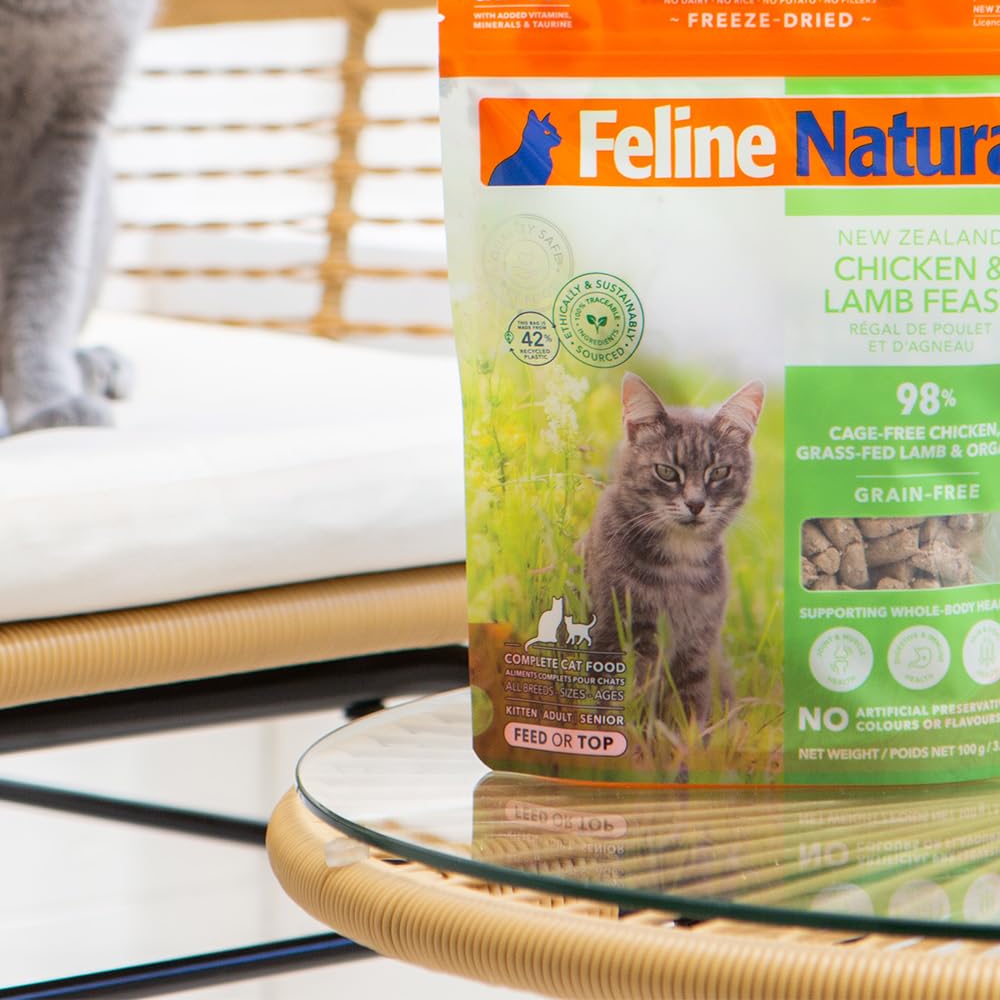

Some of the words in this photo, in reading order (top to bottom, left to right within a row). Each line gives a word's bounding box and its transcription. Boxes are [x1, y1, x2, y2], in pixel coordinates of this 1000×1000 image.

[688, 13, 853, 28] FREEZE-DRIED
[579, 103, 776, 179] Feline
[838, 229, 890, 246] NEW
[834, 256, 976, 281] CHICKEN
[586, 297, 621, 320] TRACEABLE
[824, 288, 913, 313] LAMB
[559, 284, 581, 340] ETHICALLY
[585, 280, 592, 289] &
[596, 279, 638, 341] SUSTAINABLY
[578, 328, 619, 345] INGREDIENTS
[849, 320, 900, 336] RÉGAL
[906, 323, 927, 335] DE
[933, 323, 992, 335] POULET
[576, 345, 625, 362] SOURCED
[869, 341, 887, 352] ET
[897, 382, 956, 416] 98%
[829, 426, 925, 440] CAGE-FREE
[929, 423, 1000, 439] CHICKEN,
[797, 446, 896, 460] GRASS-FED
[900, 444, 946, 459] LAMB
[950, 444, 962, 458] &
[854, 484, 980, 503] GRAIN-FREE
[800, 607, 887, 619] SUPPORTING
[891, 603, 975, 617] WHOLE-BODY
[505, 654, 558, 668] COMPLETE
[561, 659, 582, 671] CAT
[586, 661, 625, 672] FOOD
[506, 706, 537, 718] KITTEN
[543, 711, 572, 722] ADULT
[581, 714, 624, 725] SENIOR
[799, 707, 849, 731] NO
[856, 705, 929, 717] ARTIFICIAL
[856, 720, 919, 731] COLOURS
[923, 719, 941, 729] OR
[945, 713, 1000, 728] FLAVOURS
[514, 728, 547, 744] FEED
[552, 732, 572, 748] OR
[578, 735, 614, 750] TOP
[799, 748, 824, 760] NET
[827, 748, 878, 760] WEIGHT
[890, 747, 928, 759] POIDS
[931, 746, 956, 758] NET
